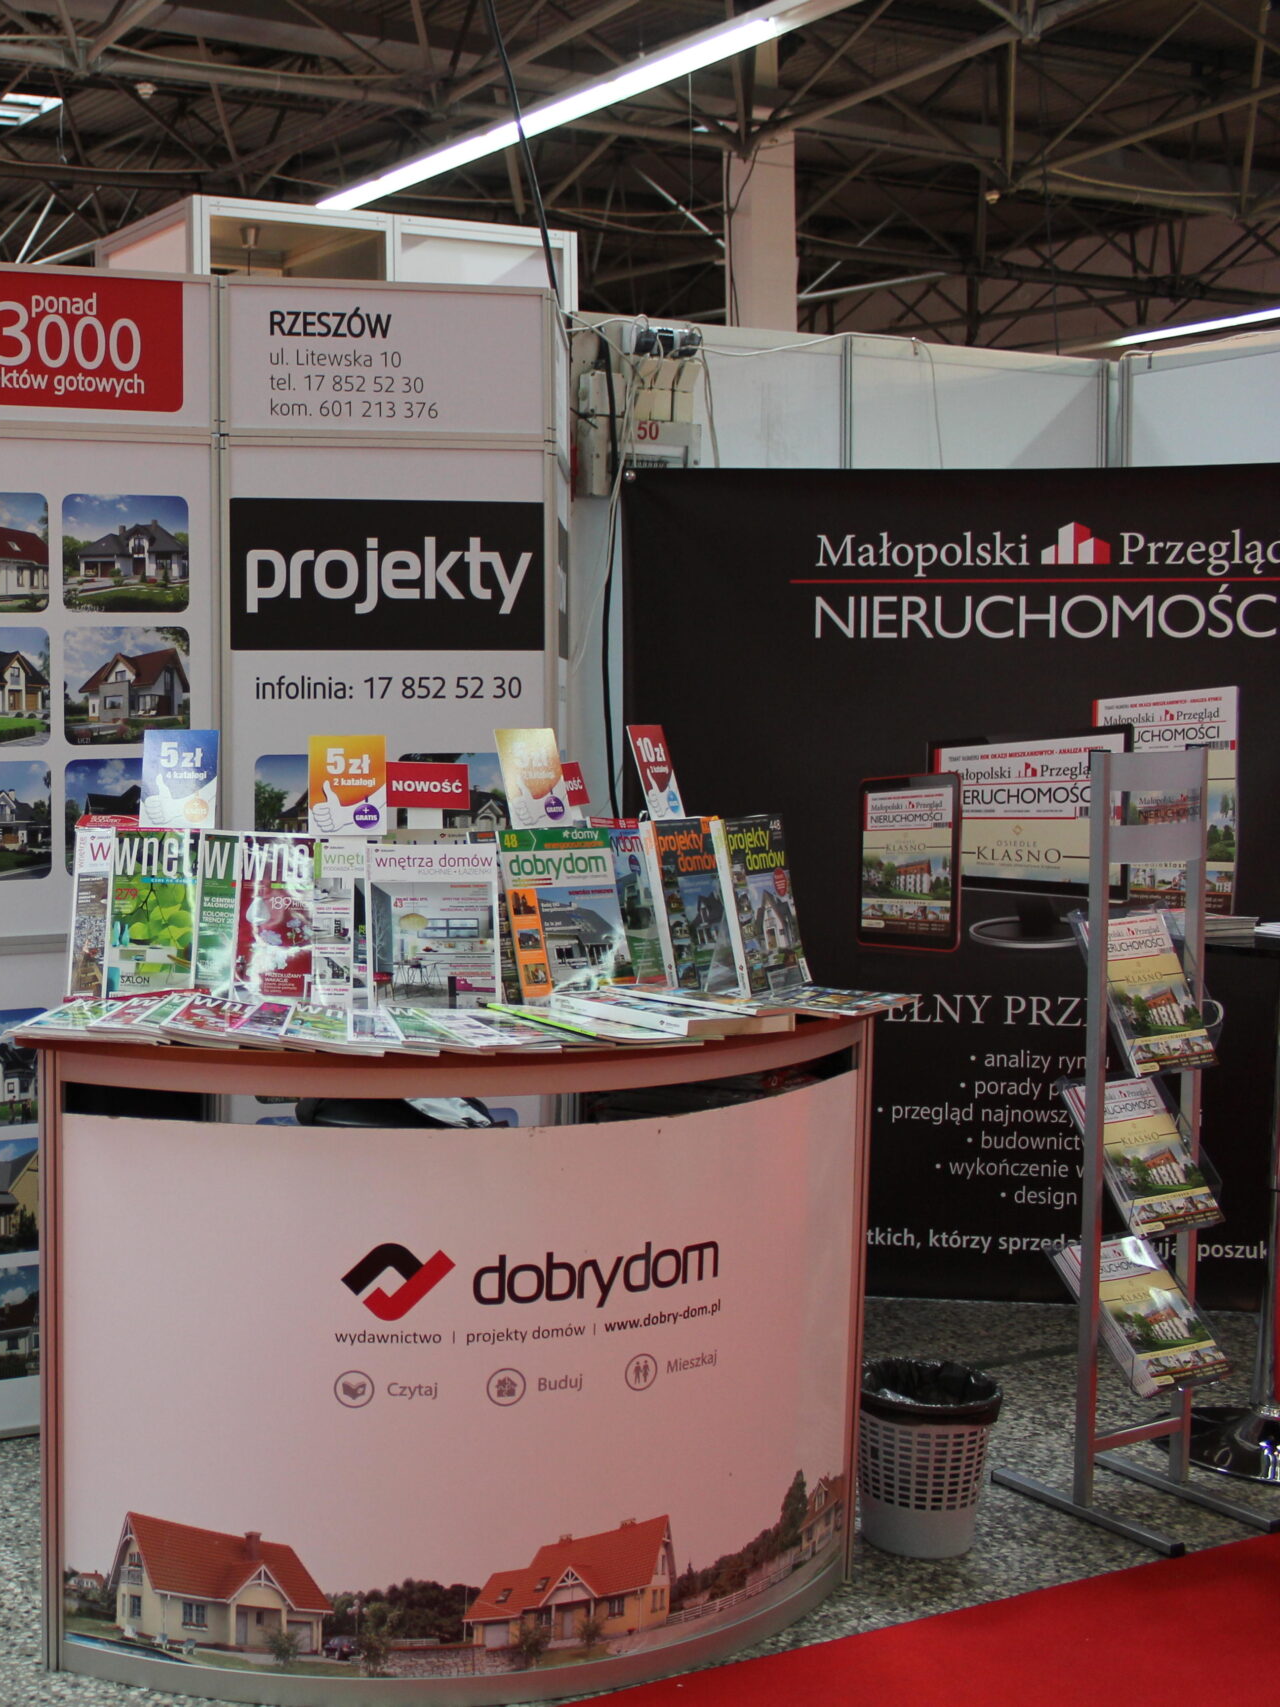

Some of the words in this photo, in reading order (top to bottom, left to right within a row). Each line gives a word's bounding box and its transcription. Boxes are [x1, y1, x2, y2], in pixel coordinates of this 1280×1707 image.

[31, 292, 98, 317] ponad
[269, 307, 392, 339] RZESZÓW
[269, 349, 290, 367] ul.
[295, 348, 373, 368] Litewska
[380, 351, 402, 368] 10
[52, 370, 146, 396] gotowych
[269, 374, 296, 392] tel.
[304, 375, 326, 392] 17
[332, 375, 368, 393] 852
[373, 376, 396, 393] 52
[401, 376, 425, 394] 30
[269, 399, 313, 417] kom.
[319, 400, 354, 418] 601
[361, 401, 397, 419] 213
[403, 402, 439, 420] 376
[637, 421, 659, 440] 50
[815, 531, 1030, 577] Małopolski
[246, 536, 532, 614] projekty
[255, 674, 354, 700] infolinia:
[363, 676, 392, 700] 17
[401, 676, 447, 700] 852
[454, 676, 484, 700] 52
[492, 676, 522, 700] 30
[1176, 707, 1220, 722] Przegląd
[160, 741, 179, 768] 5
[181, 747, 203, 768] zł
[636, 737, 655, 763] 10
[654, 743, 666, 762] zł
[326, 748, 346, 775] 5
[348, 754, 371, 775] zł
[172, 770, 207, 781] katalogi
[333, 778, 340, 786] 2
[340, 777, 376, 788] katalogi
[391, 778, 463, 794] NOWOŚĆ
[354, 814, 378, 822] GRATIS
[870, 810, 943, 824] NIERUCHOMOŚCI
[504, 834, 518, 848] 48
[570, 830, 599, 841] domy
[658, 829, 704, 856] projekty
[728, 826, 770, 855] projekty
[375, 855, 433, 870] wnętrza
[438, 854, 493, 868] domów
[508, 852, 607, 880] dobrydom
[745, 850, 785, 872] domów
[976, 846, 1061, 864] KLASNO
[115, 888, 138, 900] 279
[270, 896, 291, 910] 189
[393, 900, 403, 908] 43
[120, 975, 150, 984] SALON
[984, 1050, 1051, 1073] analizy
[974, 1079, 1042, 1101] porady
[891, 1103, 974, 1127] przegląd
[949, 1159, 1069, 1180] wykończenie
[1013, 1185, 1078, 1207] design
[928, 1229, 992, 1253] którzy
[472, 1240, 719, 1308] dobrydom
[334, 1329, 442, 1346] wydawnictwo
[465, 1326, 528, 1346] projekty
[531, 1322, 586, 1341] domów
[604, 1298, 721, 1334] www.dobry-dom.pl
[386, 1381, 438, 1399] Czytaj
[537, 1373, 584, 1392] Buduj
[665, 1349, 718, 1375] Mieszkaj
